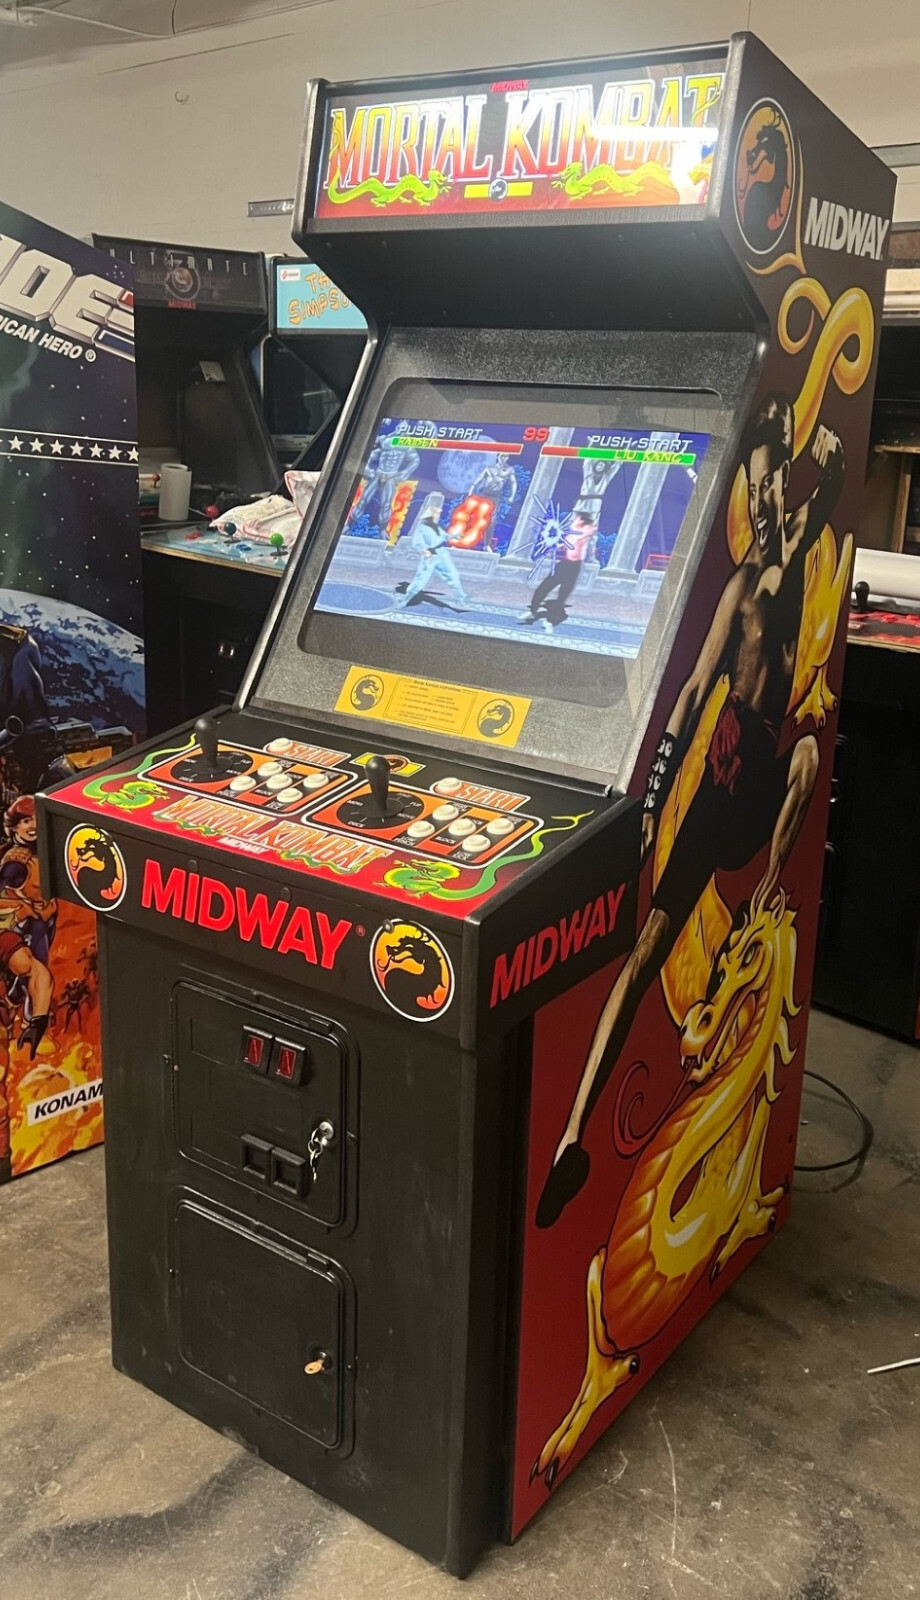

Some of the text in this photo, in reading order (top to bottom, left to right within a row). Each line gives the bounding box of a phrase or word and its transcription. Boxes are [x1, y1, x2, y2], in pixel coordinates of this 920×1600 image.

[490, 79, 529, 92] MIDWAY
[325, 73, 727, 190] MORTAL KOMBAT
[804, 196, 890, 261] MIDWAY
[38, 333, 83, 359] HERO
[398, 425, 484, 440] PUSH START
[523, 426, 550, 442] 99
[589, 435, 694, 455] PUSH START
[614, 450, 683, 463] LIU KANG
[285, 744, 341, 770] START
[458, 787, 520, 813] START
[152, 794, 277, 840] MORTAL
[219, 837, 270, 855] MIDWAY
[252, 819, 396, 873] KOMBAT
[435, 836, 457, 845] BLOCK
[141, 858, 353, 970] MIDWAY
[489, 882, 627, 1009] MIDWAY
[33, 1082, 103, 1119] KONAM
